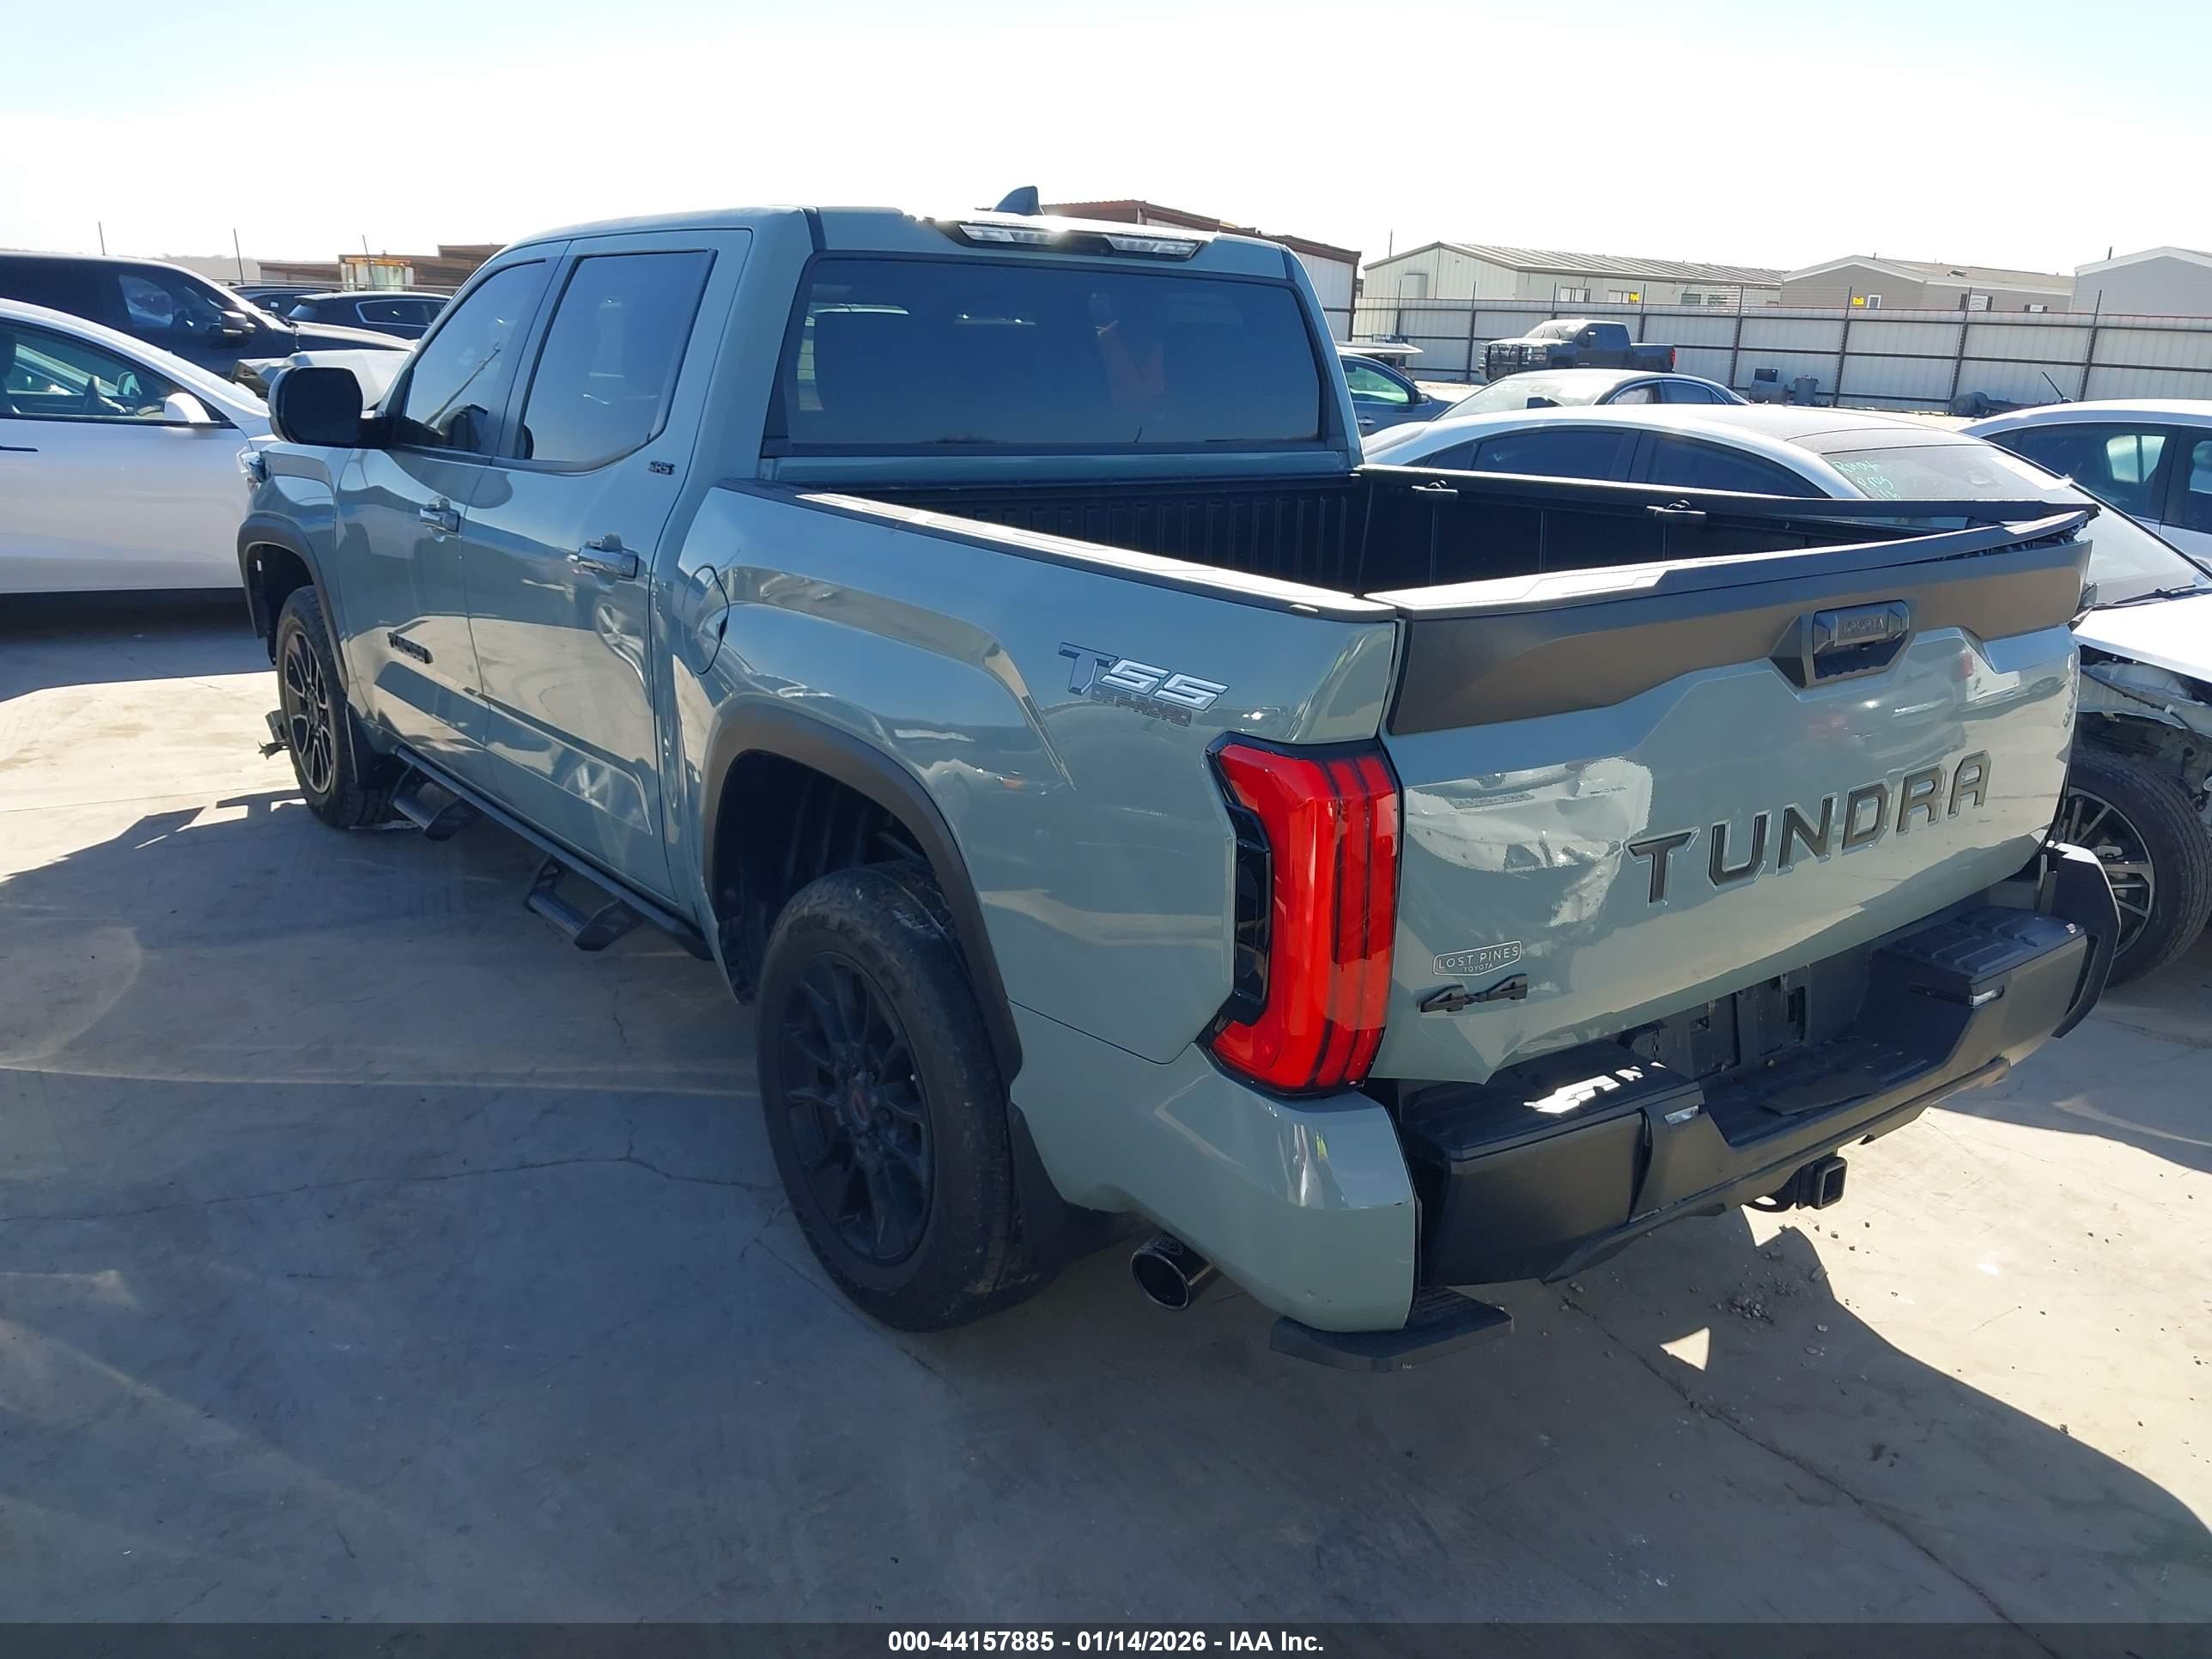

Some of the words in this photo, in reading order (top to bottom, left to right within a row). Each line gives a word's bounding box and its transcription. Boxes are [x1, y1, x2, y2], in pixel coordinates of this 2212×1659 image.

[1625, 749, 1992, 908] TUNDRA
[1438, 954, 1474, 969] LOST
[1480, 945, 1519, 963] PINES
[1463, 962, 1495, 974] TOYOTA
